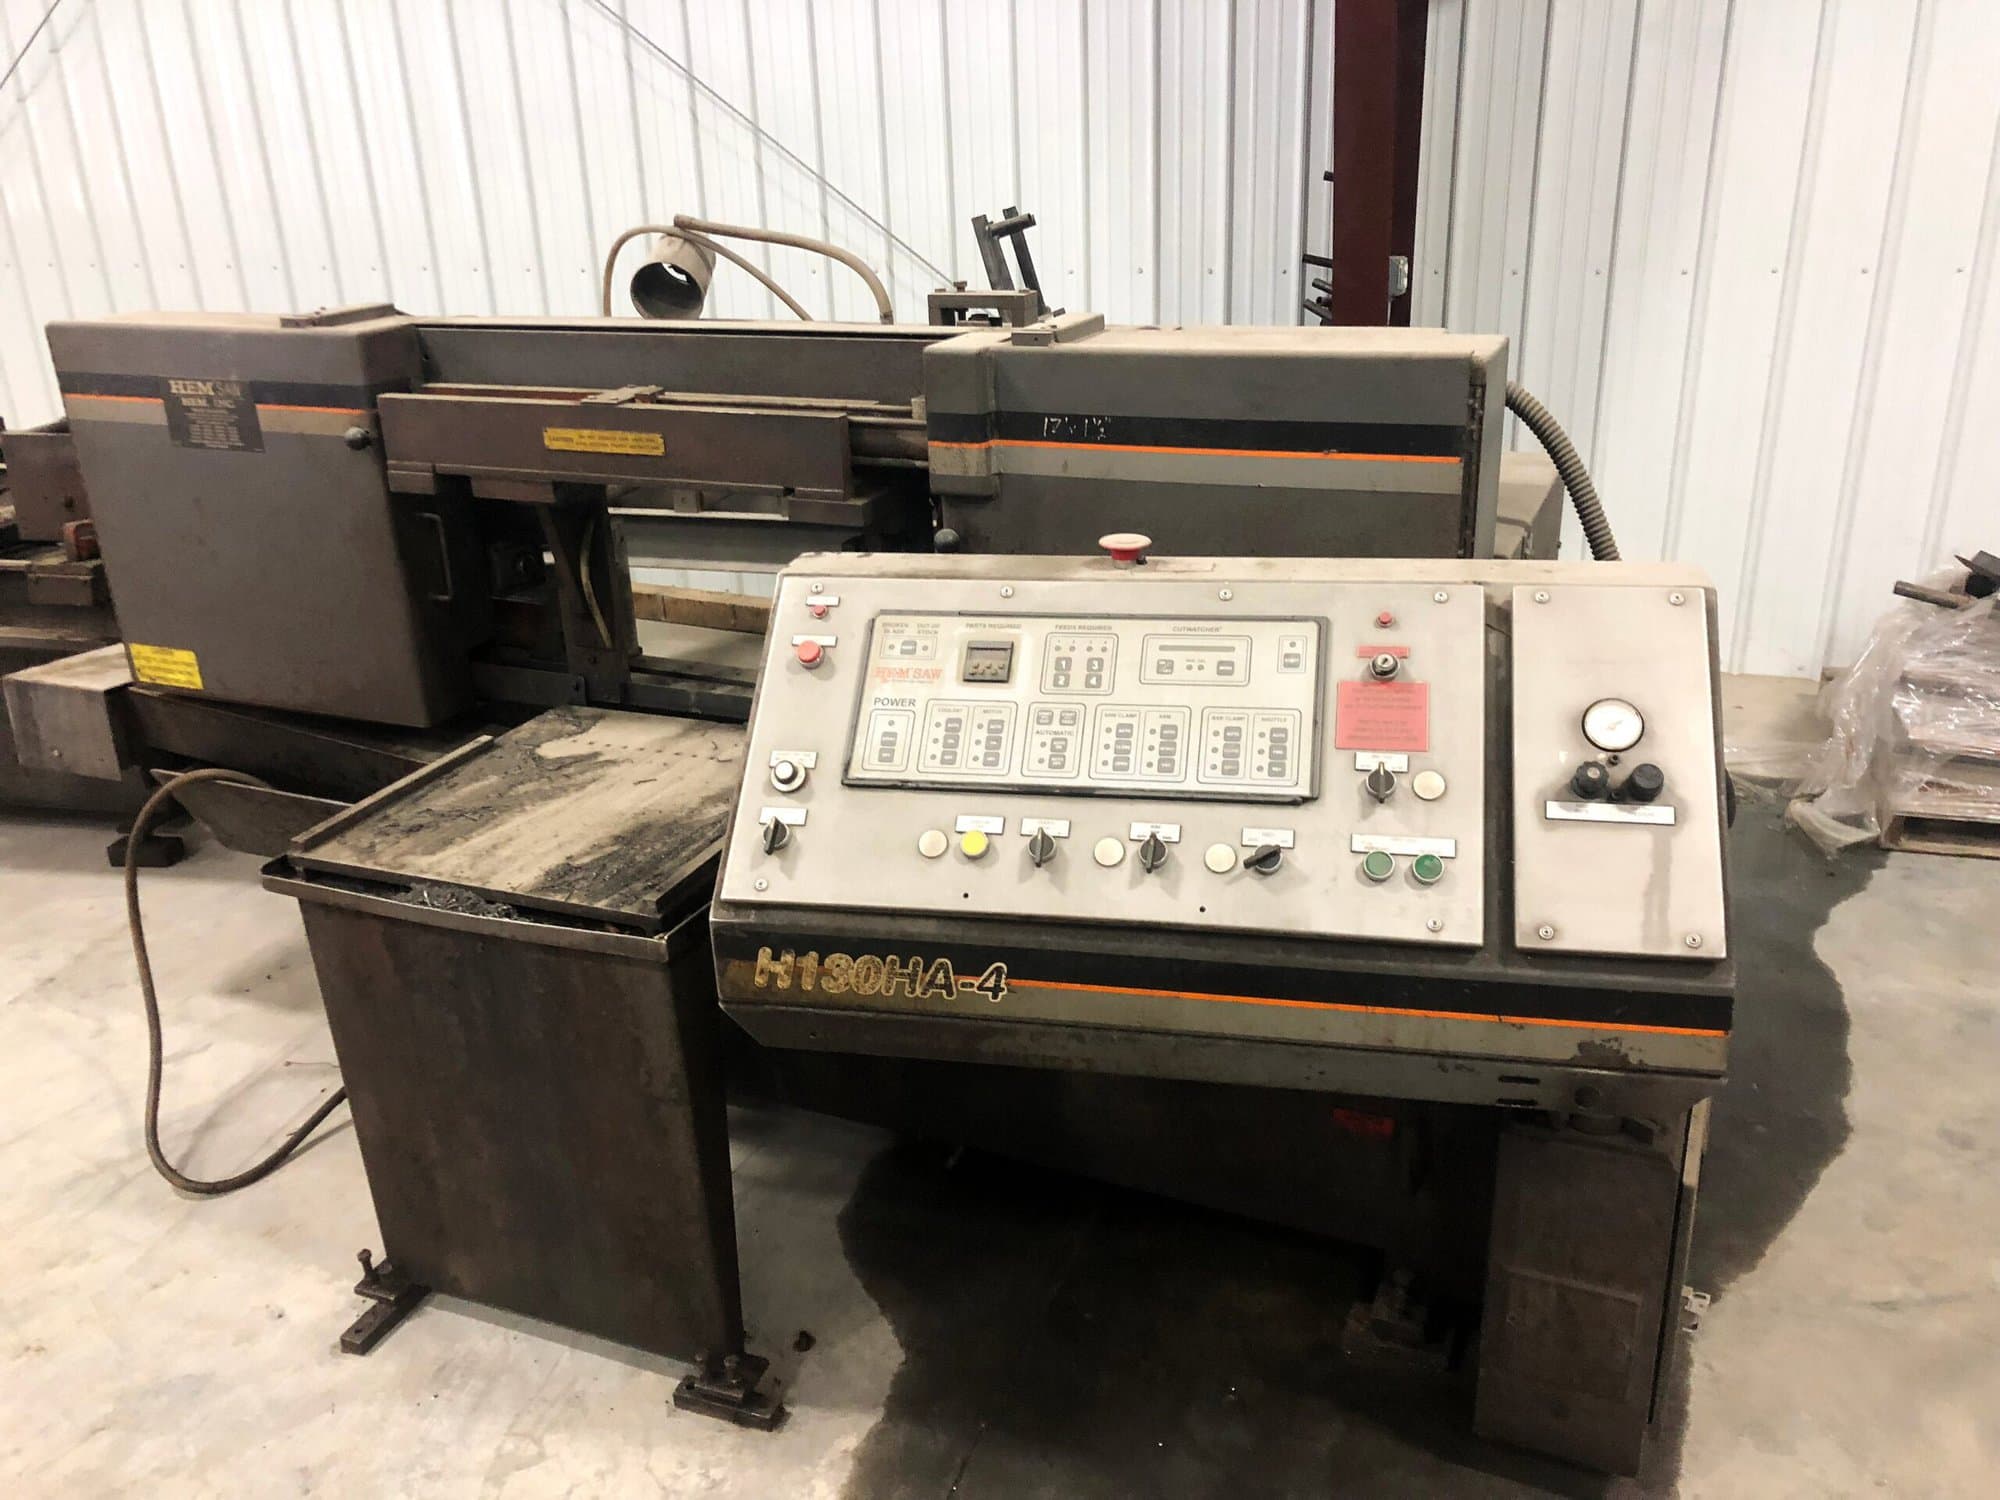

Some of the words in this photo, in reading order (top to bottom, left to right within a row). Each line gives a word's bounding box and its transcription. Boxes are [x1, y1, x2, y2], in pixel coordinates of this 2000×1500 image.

[168, 379, 215, 396] HEM
[912, 668, 943, 681] SAW
[873, 697, 917, 708] POWER
[753, 946, 1007, 1002] H130HA-4
